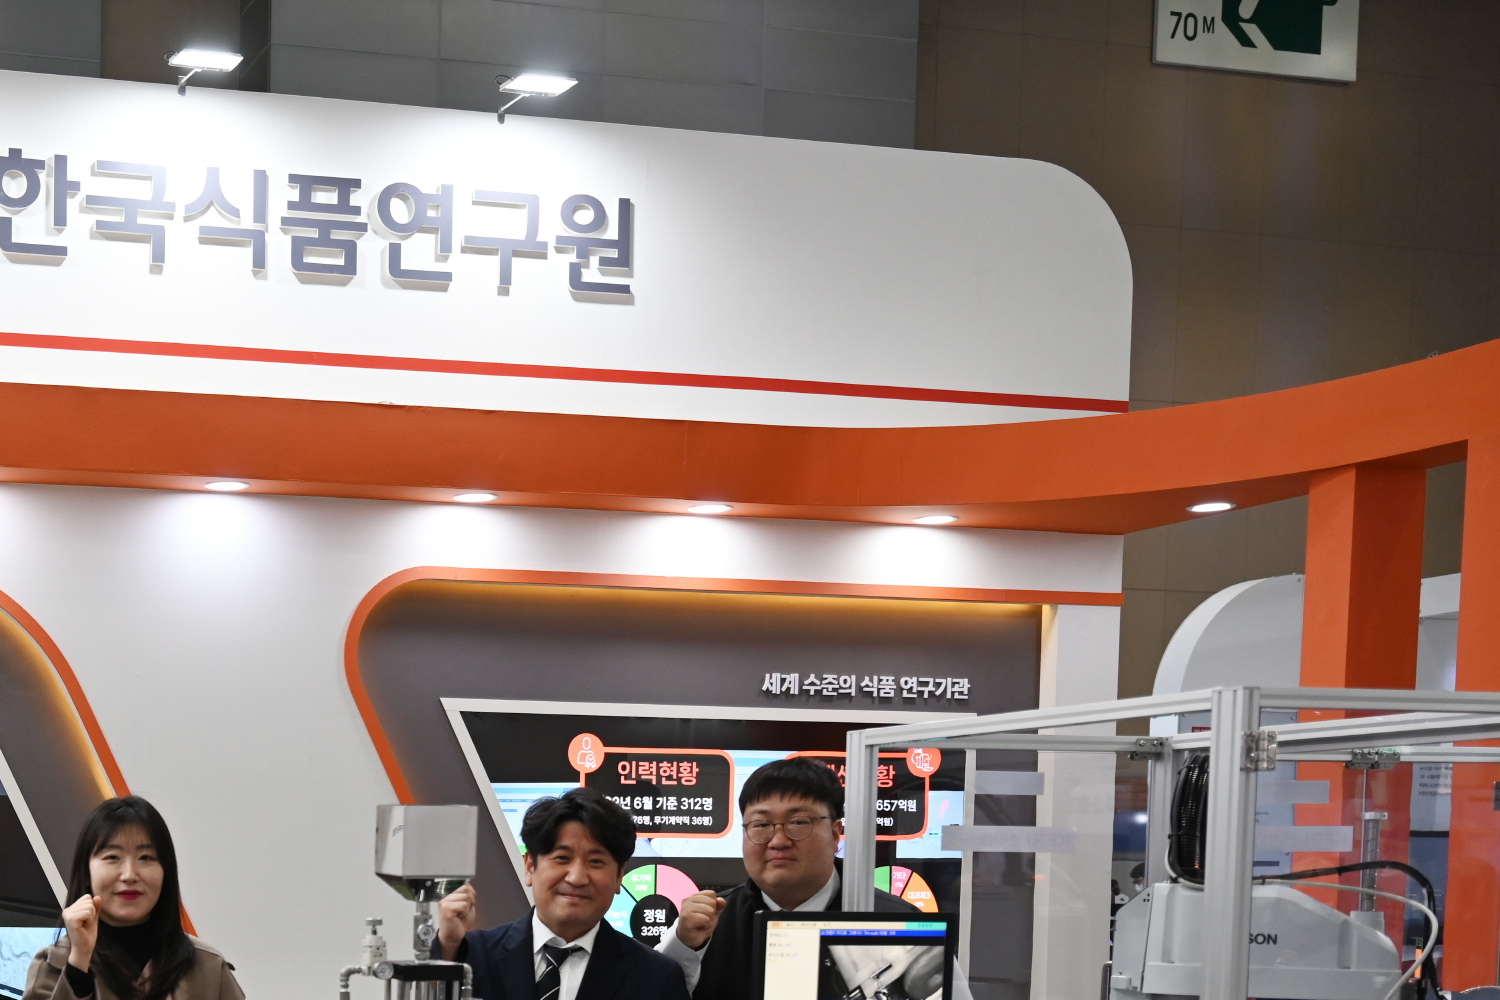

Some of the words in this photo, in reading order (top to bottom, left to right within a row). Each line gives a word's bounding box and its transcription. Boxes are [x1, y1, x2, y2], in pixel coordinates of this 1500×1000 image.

[762, 673, 799, 695] 세계
[802, 674, 856, 696] 수준의
[860, 675, 896, 698] 식품
[900, 676, 970, 699] 연구기관
[618, 761, 699, 786] 인력현황
[633, 796, 653, 811] 6월
[656, 796, 678, 811] 기준
[680, 797, 713, 811] 312명
[632, 816, 653, 826] 76명,
[643, 908, 666, 924] 정원
[1248, 933, 1278, 946] SON
